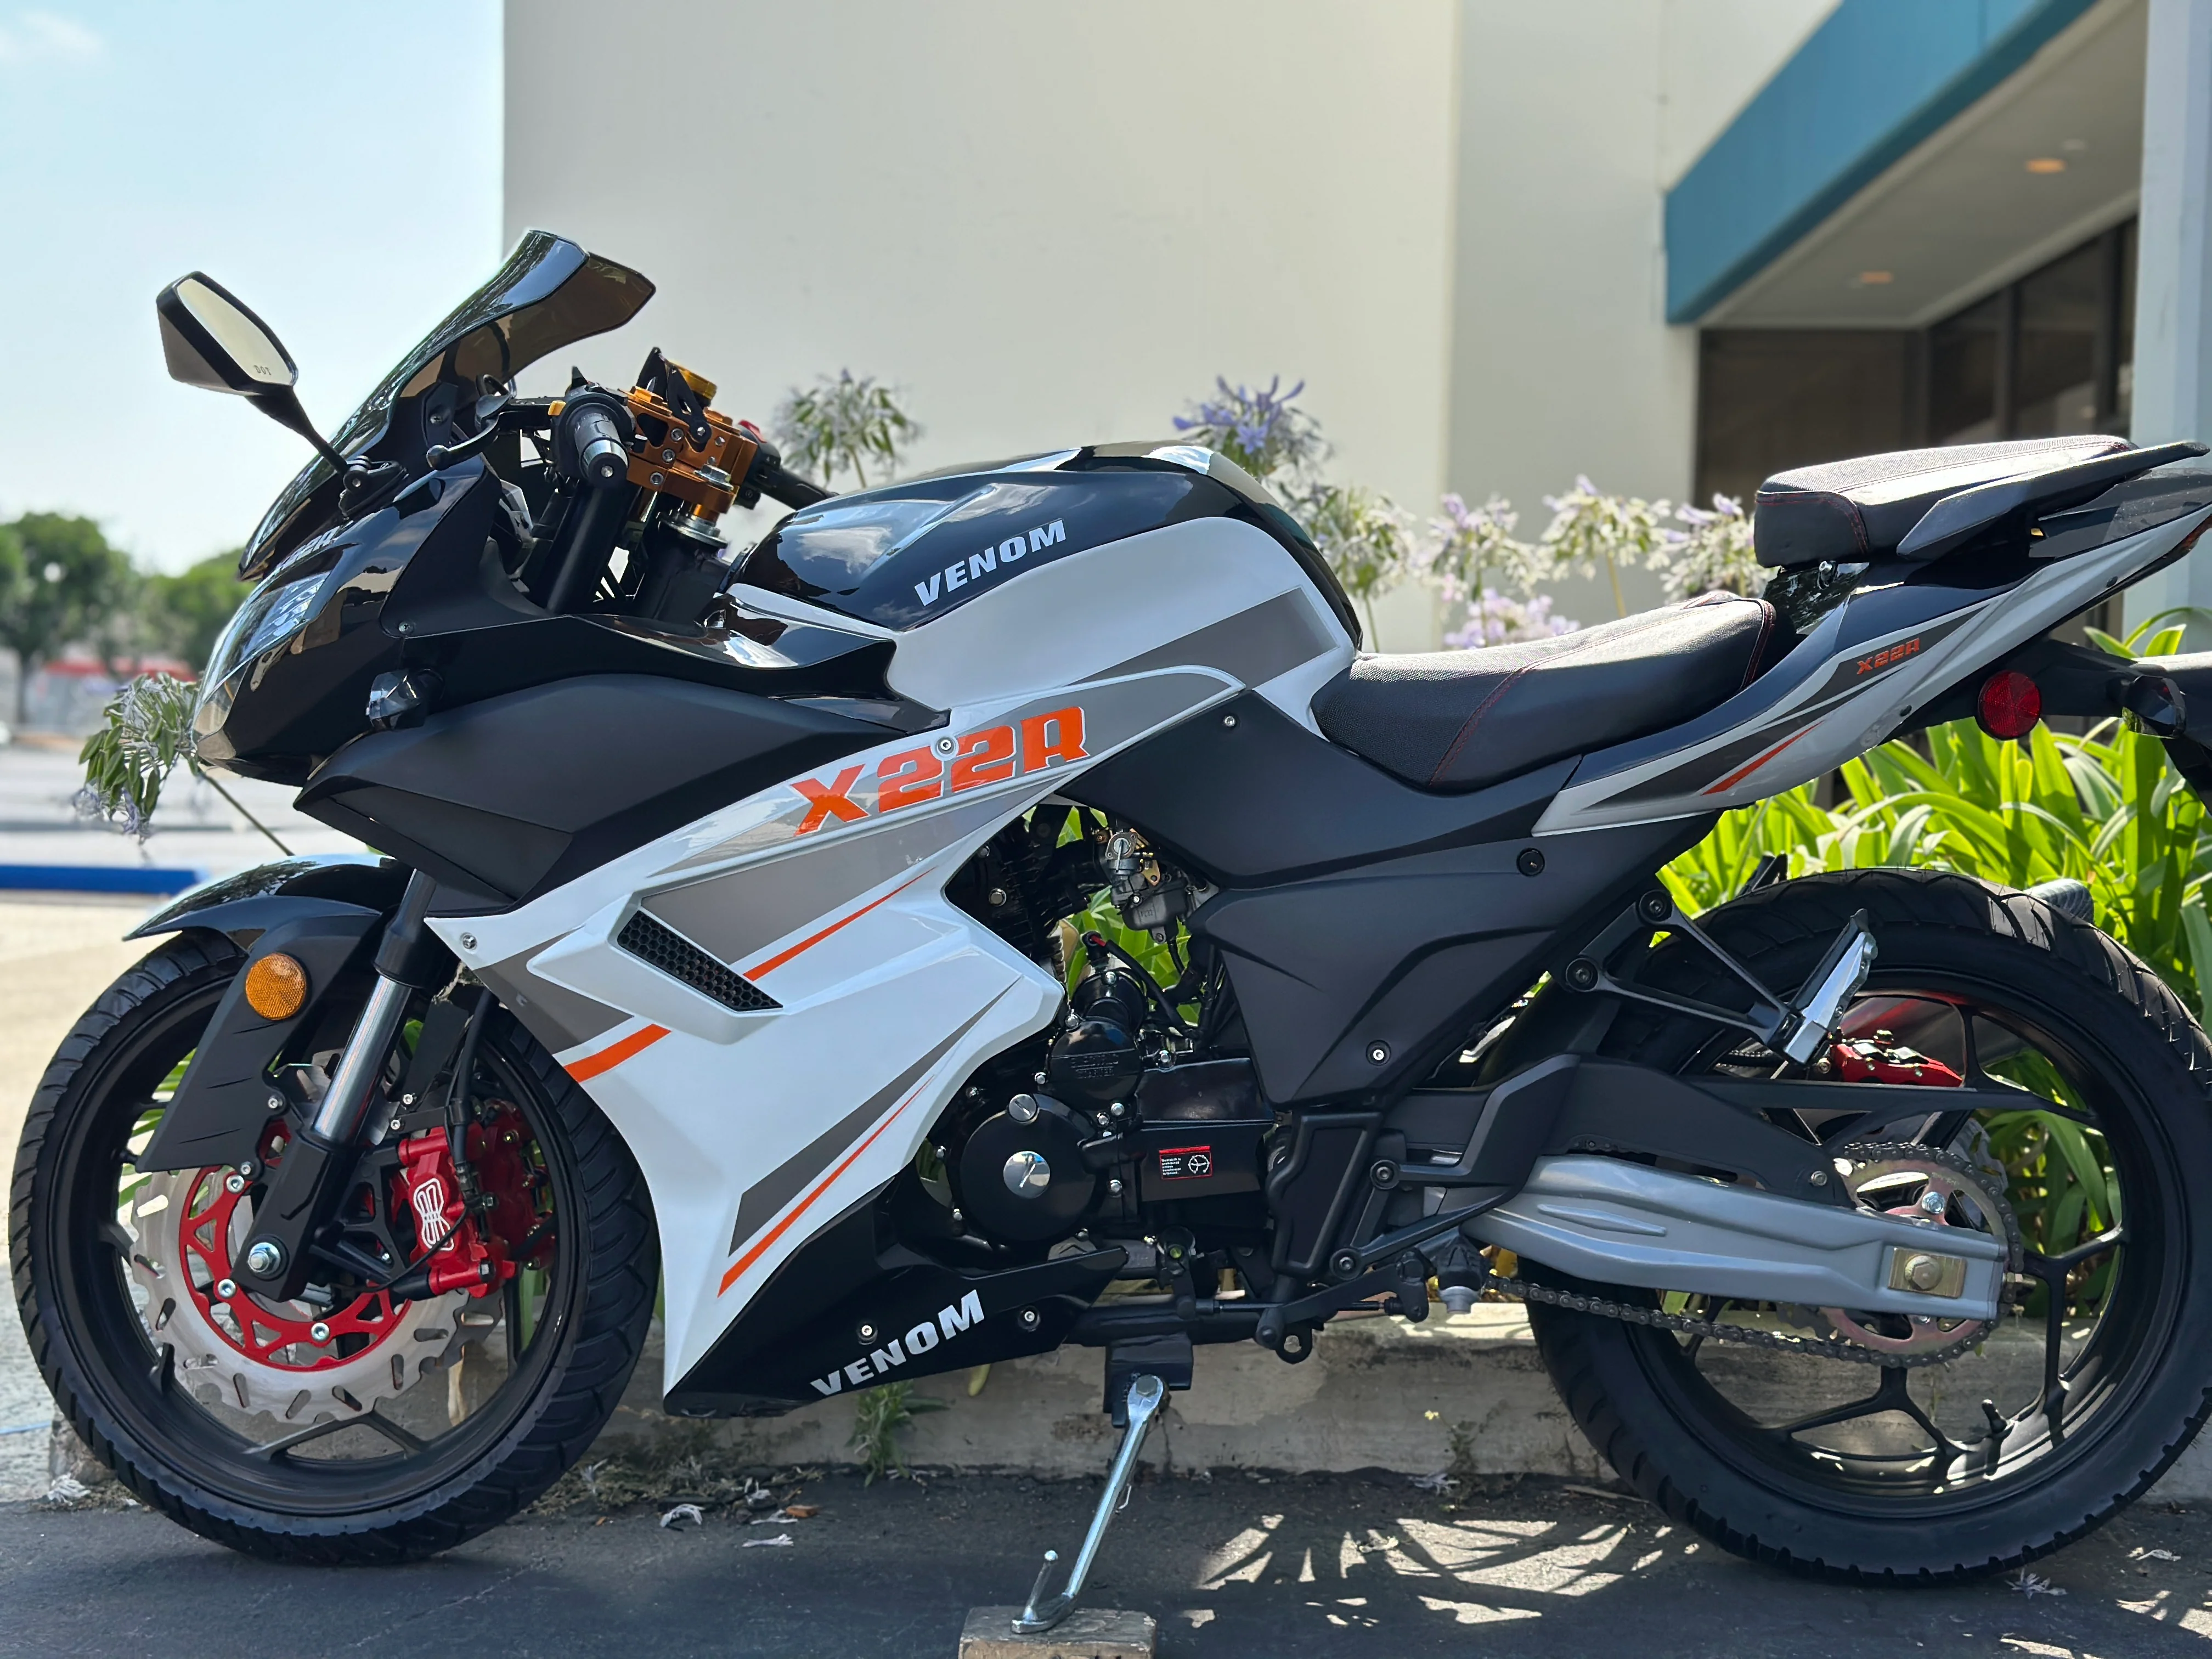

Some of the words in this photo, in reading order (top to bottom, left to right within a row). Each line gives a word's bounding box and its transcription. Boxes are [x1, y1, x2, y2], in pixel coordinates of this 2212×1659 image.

[914, 520, 1066, 606] VENOM
[1857, 637, 1920, 675] X22R
[790, 706, 1090, 837] X22R
[810, 1289, 985, 1396] VENOM
